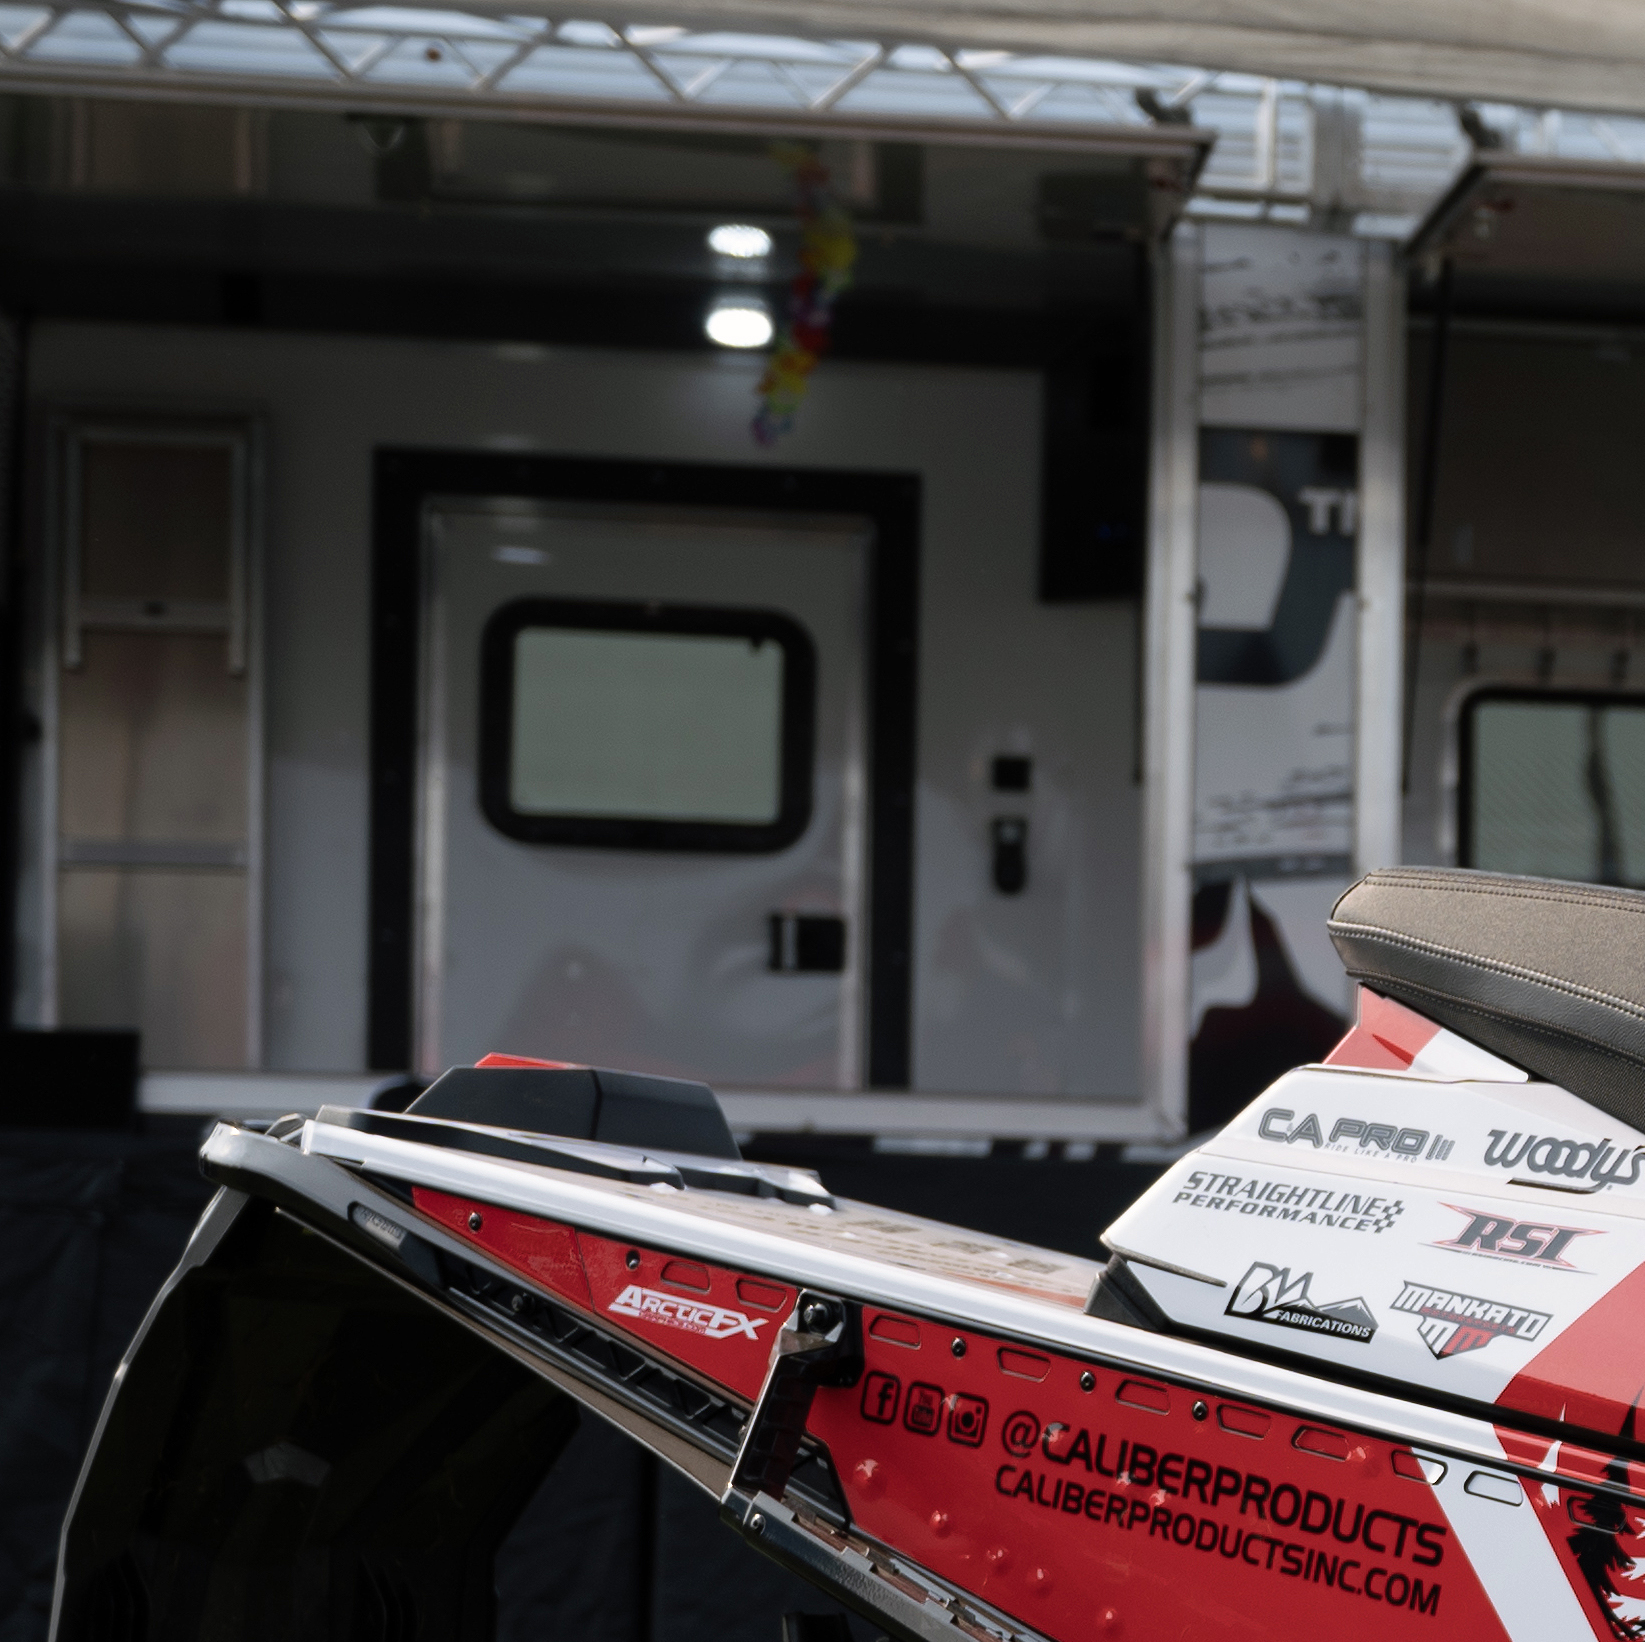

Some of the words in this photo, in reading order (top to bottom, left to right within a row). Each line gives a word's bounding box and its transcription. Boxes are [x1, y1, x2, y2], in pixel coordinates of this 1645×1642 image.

[1324, 1142, 1347, 1153] RIDE
[1354, 1147, 1379, 1158] LIKE
[1397, 1153, 1418, 1164] PRO
[1328, 1117, 1430, 1156] PRO
[1172, 1191, 1373, 1232] PERFORMANCE
[1183, 1170, 1388, 1218] STRAIGHTLINE
[1447, 1210, 1592, 1264] RSI
[1276, 1310, 1372, 1338] FABRICATIONS
[1393, 1283, 1551, 1340] MANKATO
[1001, 1410, 1447, 1567] @CALIBERPRODUCTS
[995, 1464, 1442, 1617] CALIBERPRODUCTSINC.COM
